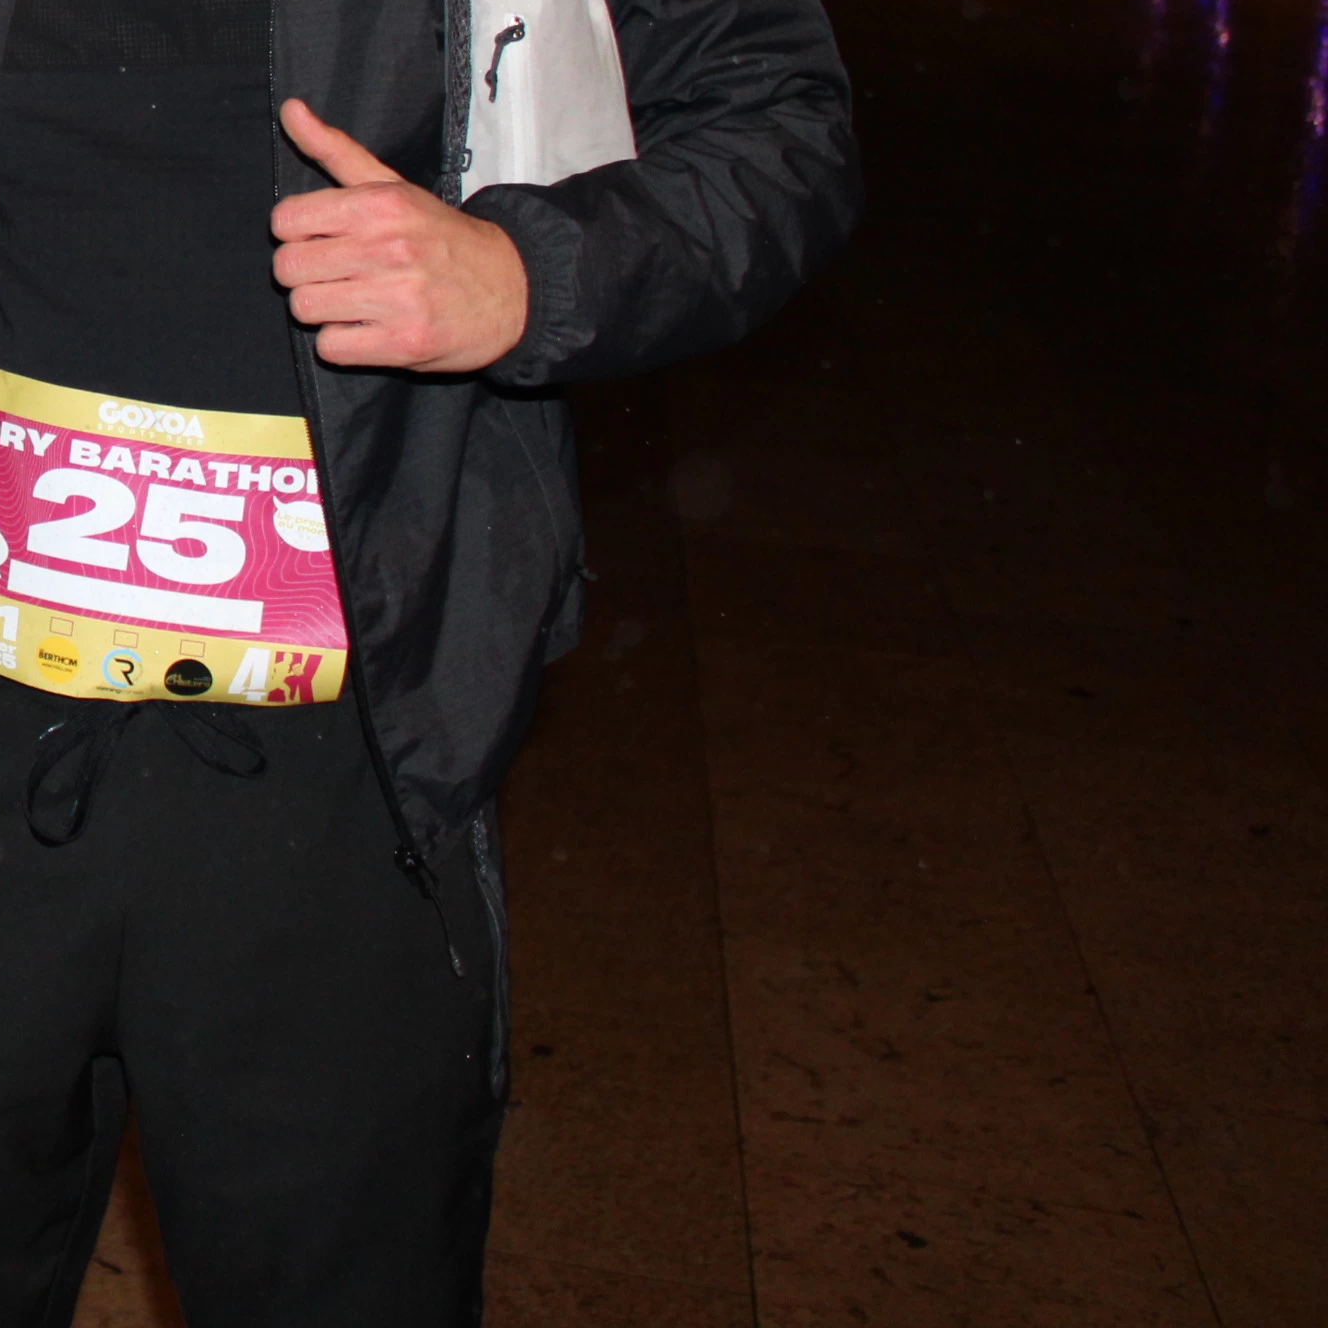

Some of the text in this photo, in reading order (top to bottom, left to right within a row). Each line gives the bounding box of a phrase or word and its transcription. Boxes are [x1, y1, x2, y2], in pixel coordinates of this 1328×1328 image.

[98, 400, 205, 438] GOXOA
[26, 468, 246, 585] 25
[227, 647, 324, 704] 4K
